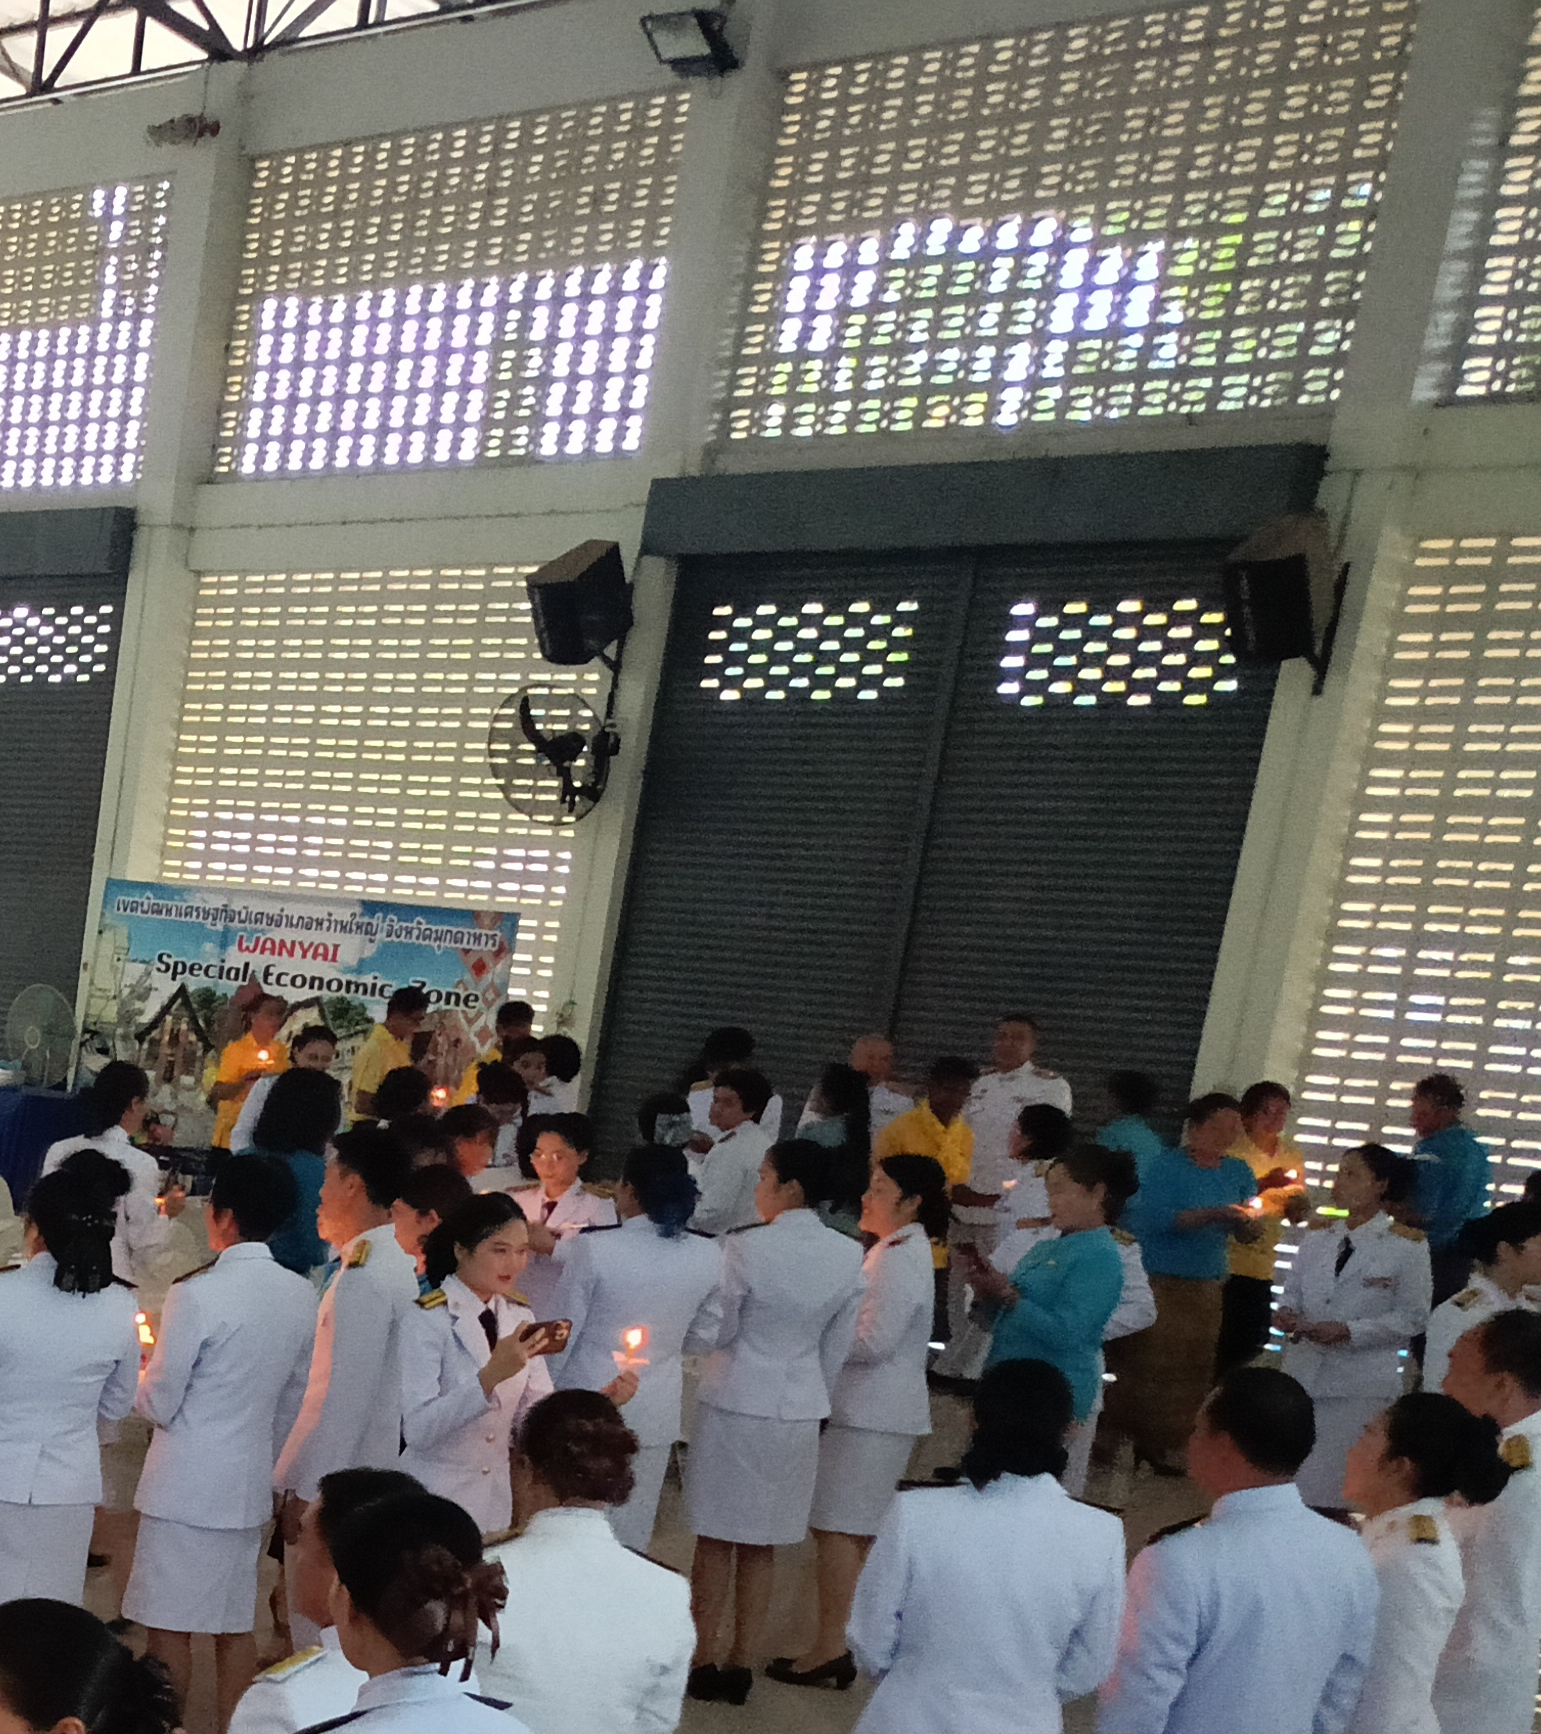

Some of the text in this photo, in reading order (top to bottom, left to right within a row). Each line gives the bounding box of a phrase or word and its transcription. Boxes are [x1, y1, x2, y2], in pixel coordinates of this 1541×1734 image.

[236, 934, 341, 963] WANYAI
[385, 917, 499, 950] จังหวัดมุกดาหาร
[156, 952, 250, 982] Special
[263, 964, 393, 999] Economic
